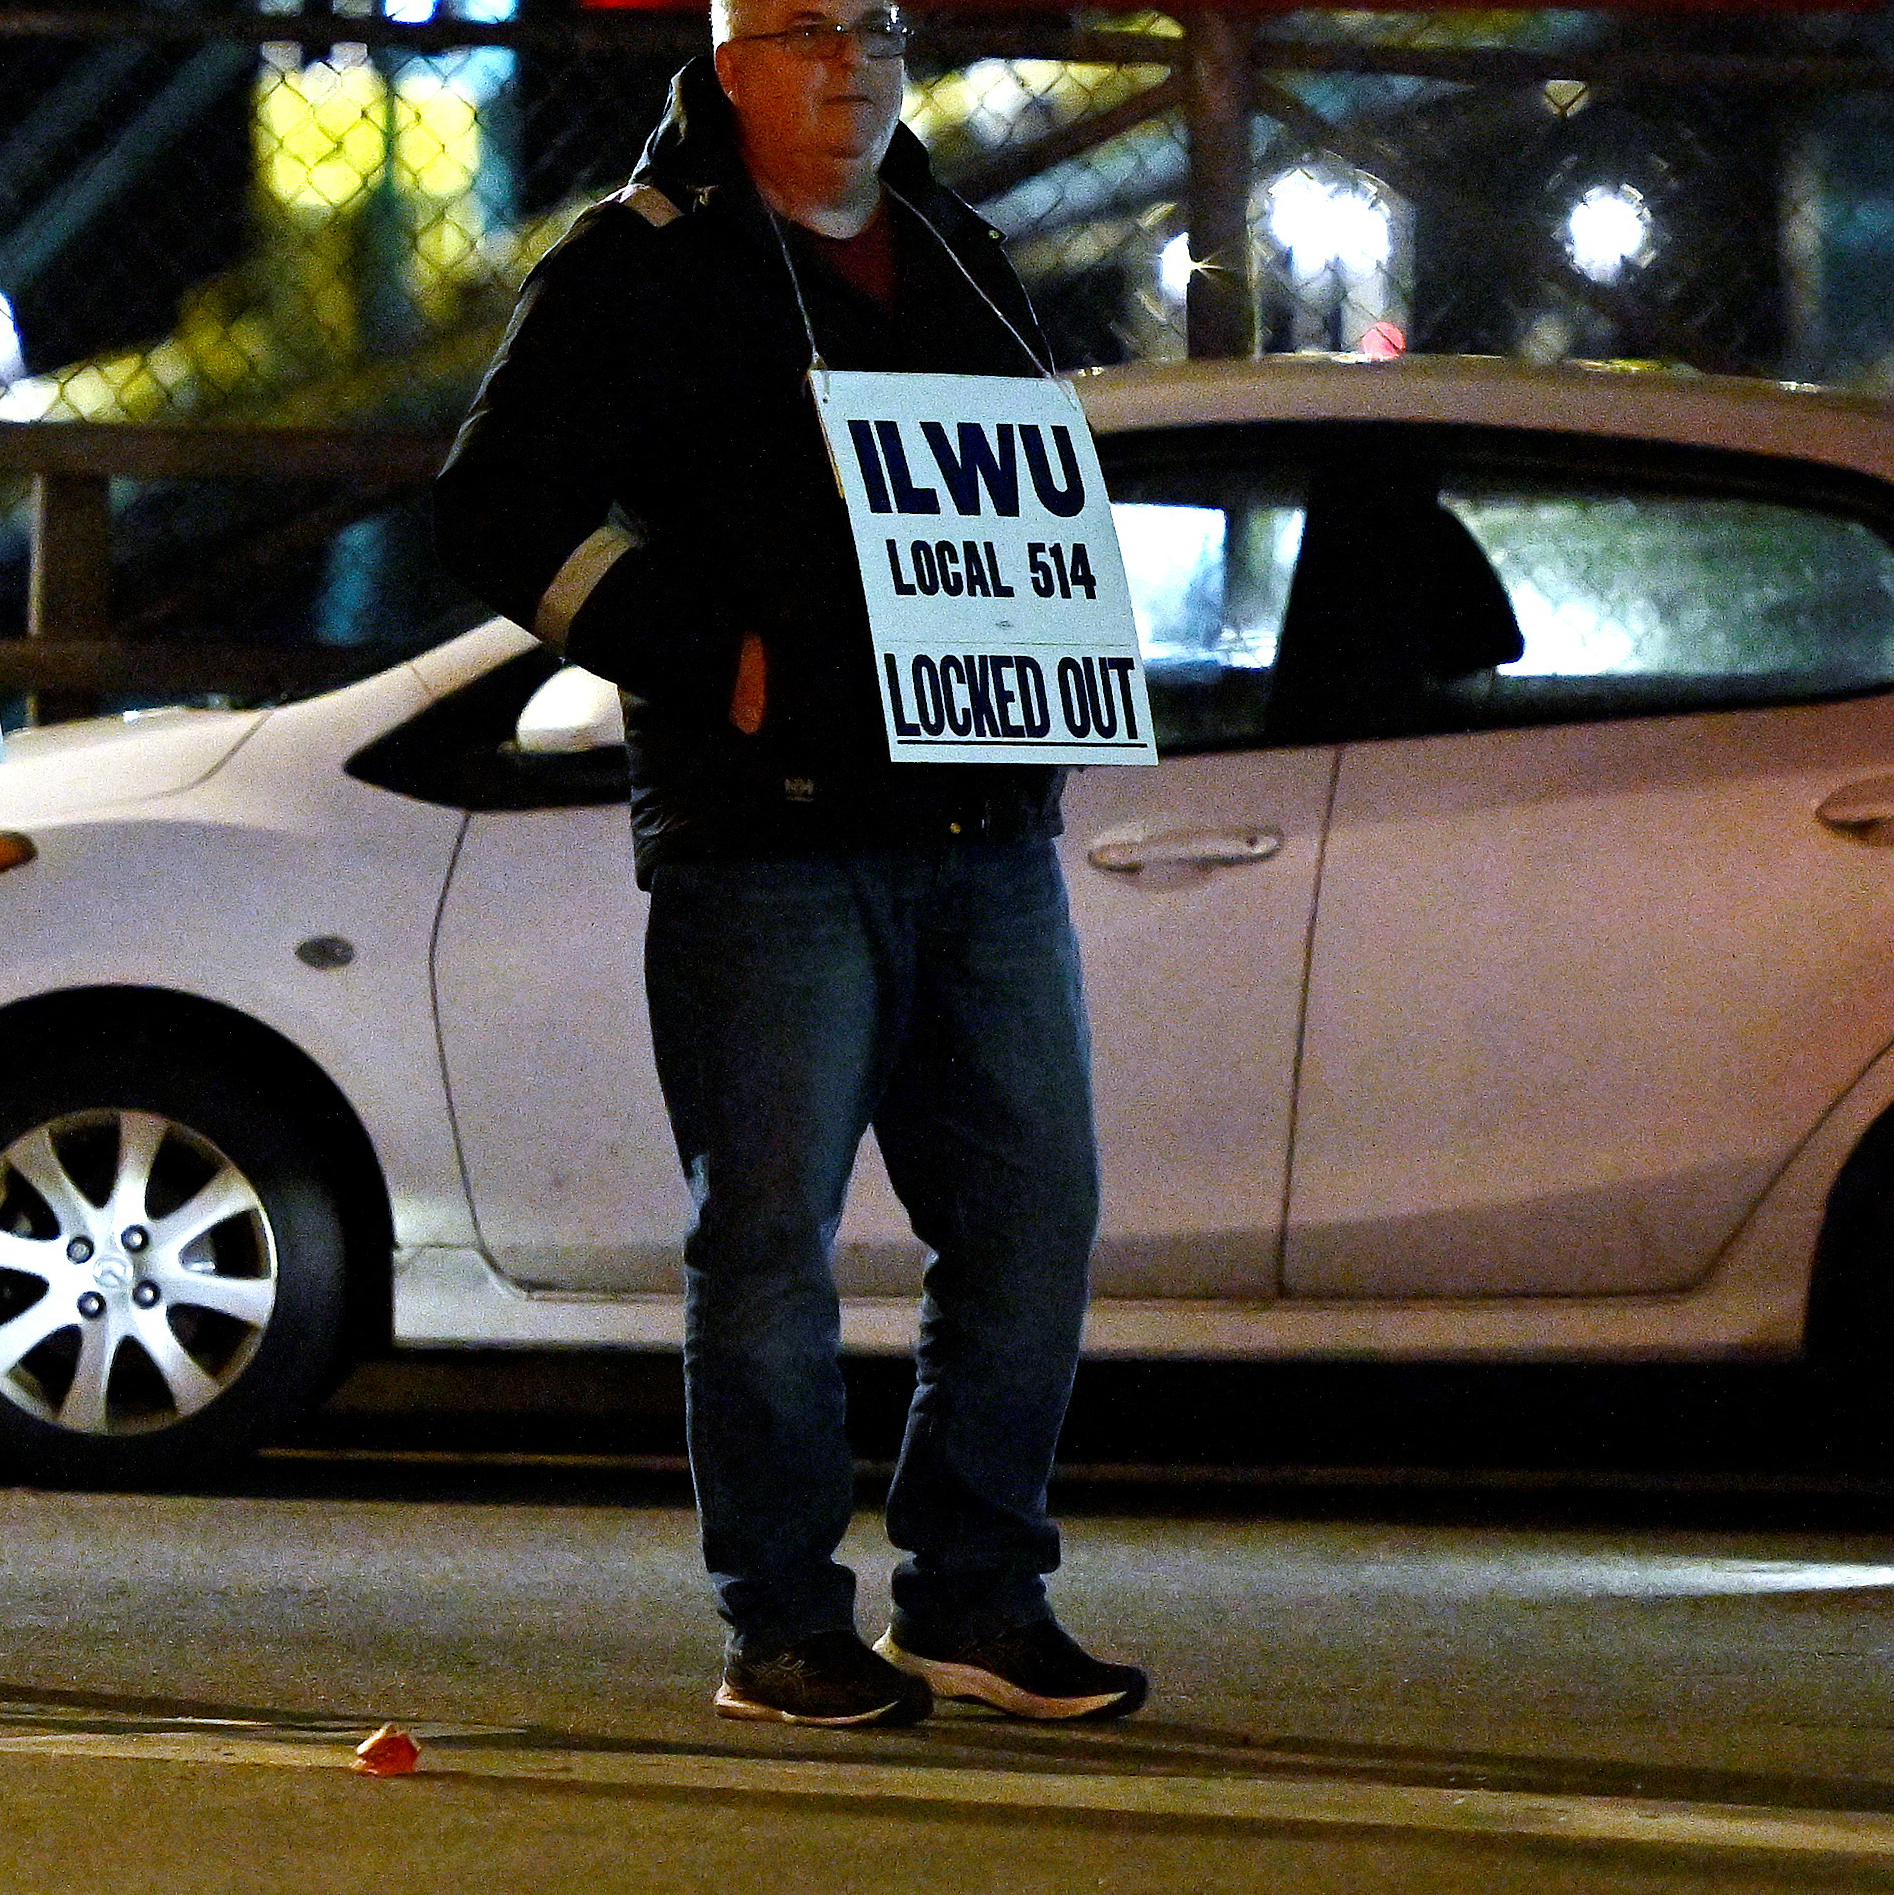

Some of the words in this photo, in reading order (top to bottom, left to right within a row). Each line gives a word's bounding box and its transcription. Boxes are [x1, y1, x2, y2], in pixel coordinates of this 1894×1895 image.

[846, 419, 1086, 517] ILWU
[885, 538, 1014, 599] LOCAL
[1028, 542, 1097, 600] 514
[883, 652, 1051, 739] LOCKED
[1057, 656, 1139, 740] OUT
